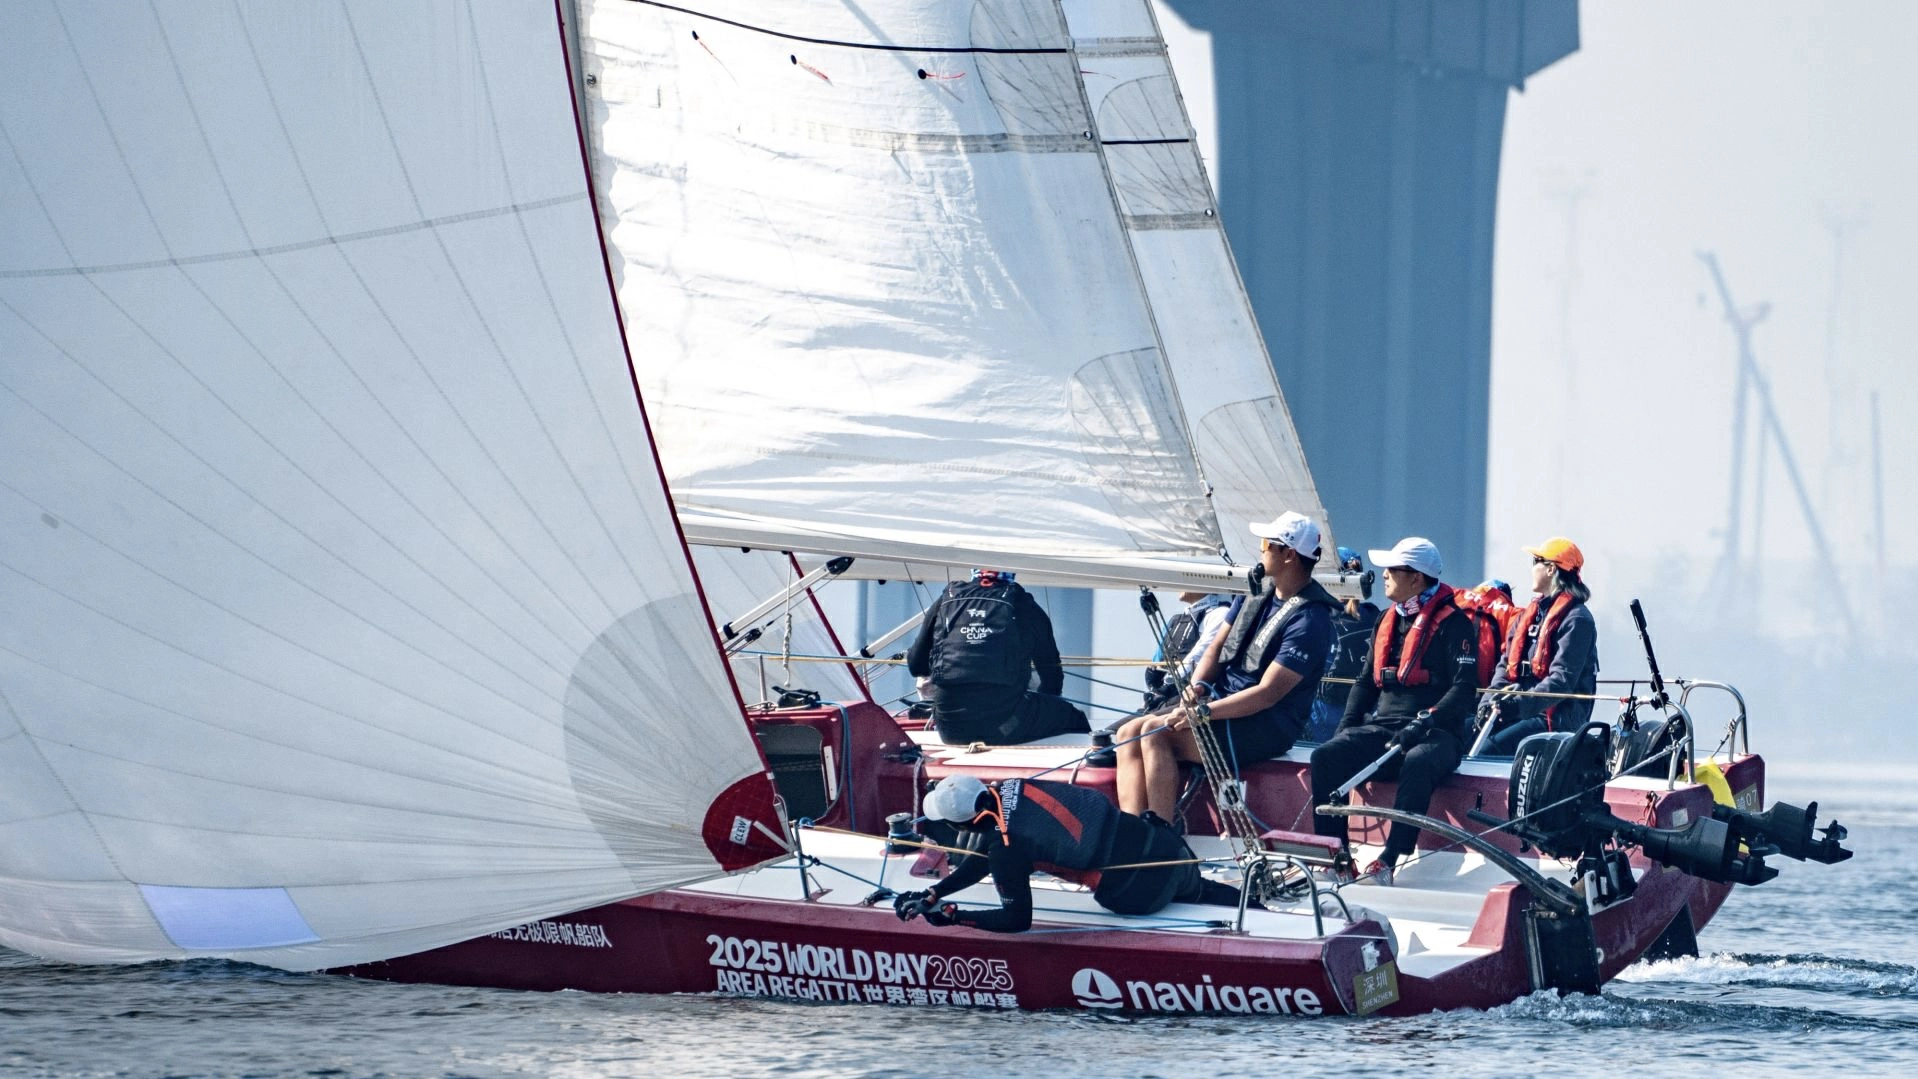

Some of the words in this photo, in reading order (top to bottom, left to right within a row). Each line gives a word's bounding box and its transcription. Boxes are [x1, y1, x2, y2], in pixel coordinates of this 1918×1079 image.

[960, 626, 993, 634] CHINA
[1516, 754, 1535, 819] SUZUKI
[734, 820, 747, 842] CLEW
[706, 934, 783, 974] 2025
[781, 942, 873, 981] WORLD
[874, 951, 929, 986] BAY
[928, 954, 1014, 991] 2025
[716, 969, 769, 996] AREA
[767, 974, 862, 1003] REGATTA
[1363, 970, 1389, 997] 深圳
[1362, 989, 1393, 1010] SHENZHEN
